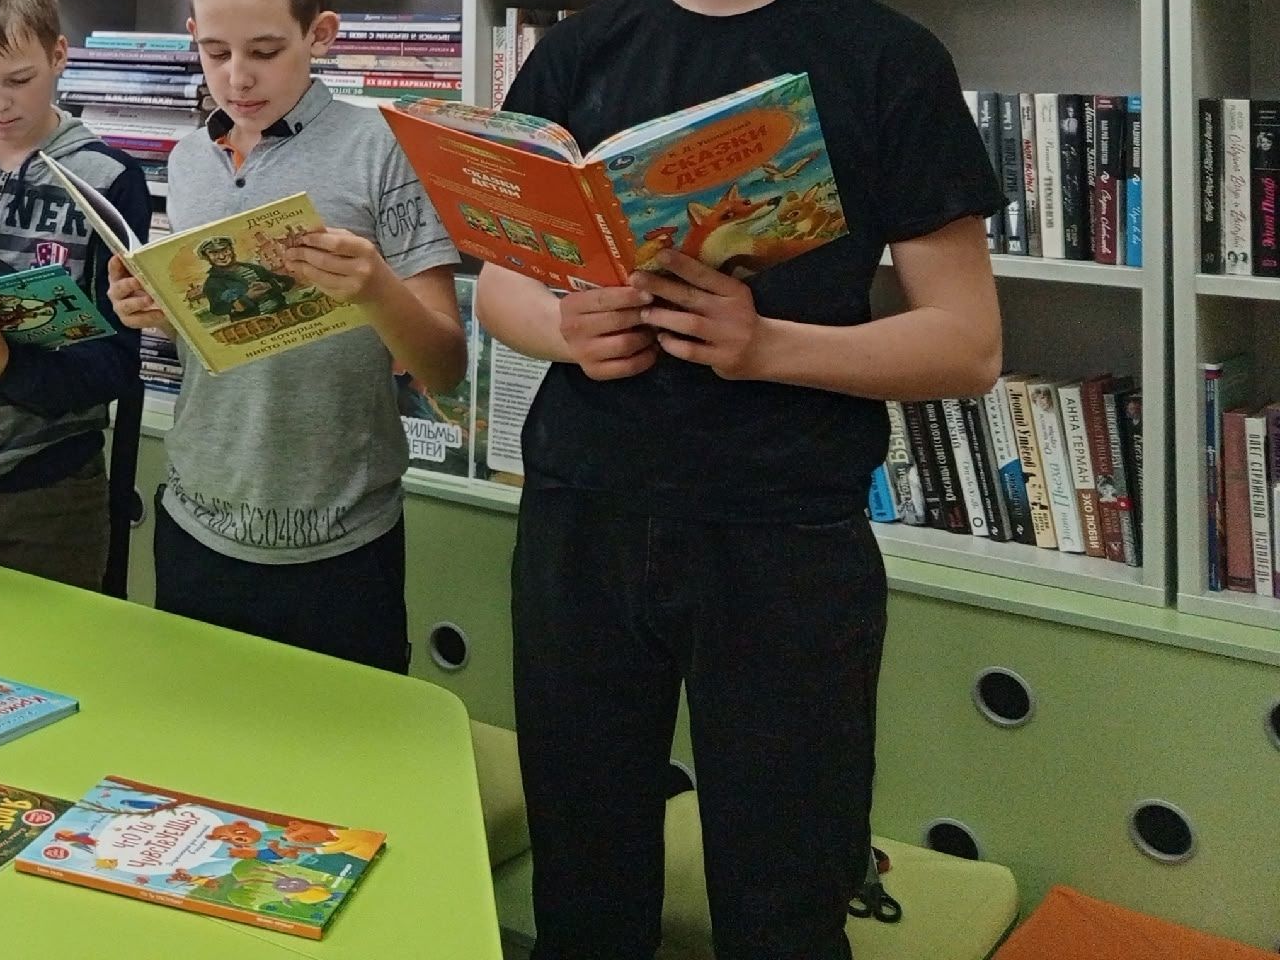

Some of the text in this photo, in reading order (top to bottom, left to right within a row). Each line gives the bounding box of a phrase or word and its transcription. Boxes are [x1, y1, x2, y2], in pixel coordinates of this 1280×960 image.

[402, 79, 451, 87] КАРИКАТУРАХ
[660, 123, 769, 178] СКАЗКИ
[1084, 102, 1094, 186] Михаил Ульянов
[462, 166, 521, 192] СКАЗКИ
[674, 143, 765, 191] ДЕТЯМ
[471, 178, 521, 200] ДЕТЯМ
[1043, 175, 1053, 228] ТИХОНОВ
[265, 209, 304, 228] Урбан
[1261, 177, 1274, 248] Эдит Пиаф
[245, 343, 281, 359] никто
[301, 321, 347, 341] дружил
[270, 321, 323, 341] которым
[1008, 387, 1029, 428] Леонид
[929, 421, 947, 465] СОВЕТСКОГО
[1064, 396, 1089, 484] АННА ГЕРМАН
[937, 464, 955, 502] КРАСАВЦЫ
[1081, 492, 1099, 548] ЭХО ЛЮБВИ
[1249, 433, 1270, 583] ОЛЕГ СТРИЖЕНОВ ИСПОВЕДЬ
[3, 797, 33, 811] Я
[112, 820, 156, 851] ЧТО ТЫ
[126, 810, 202, 869] ЧУВСТВУЕШЬ?
